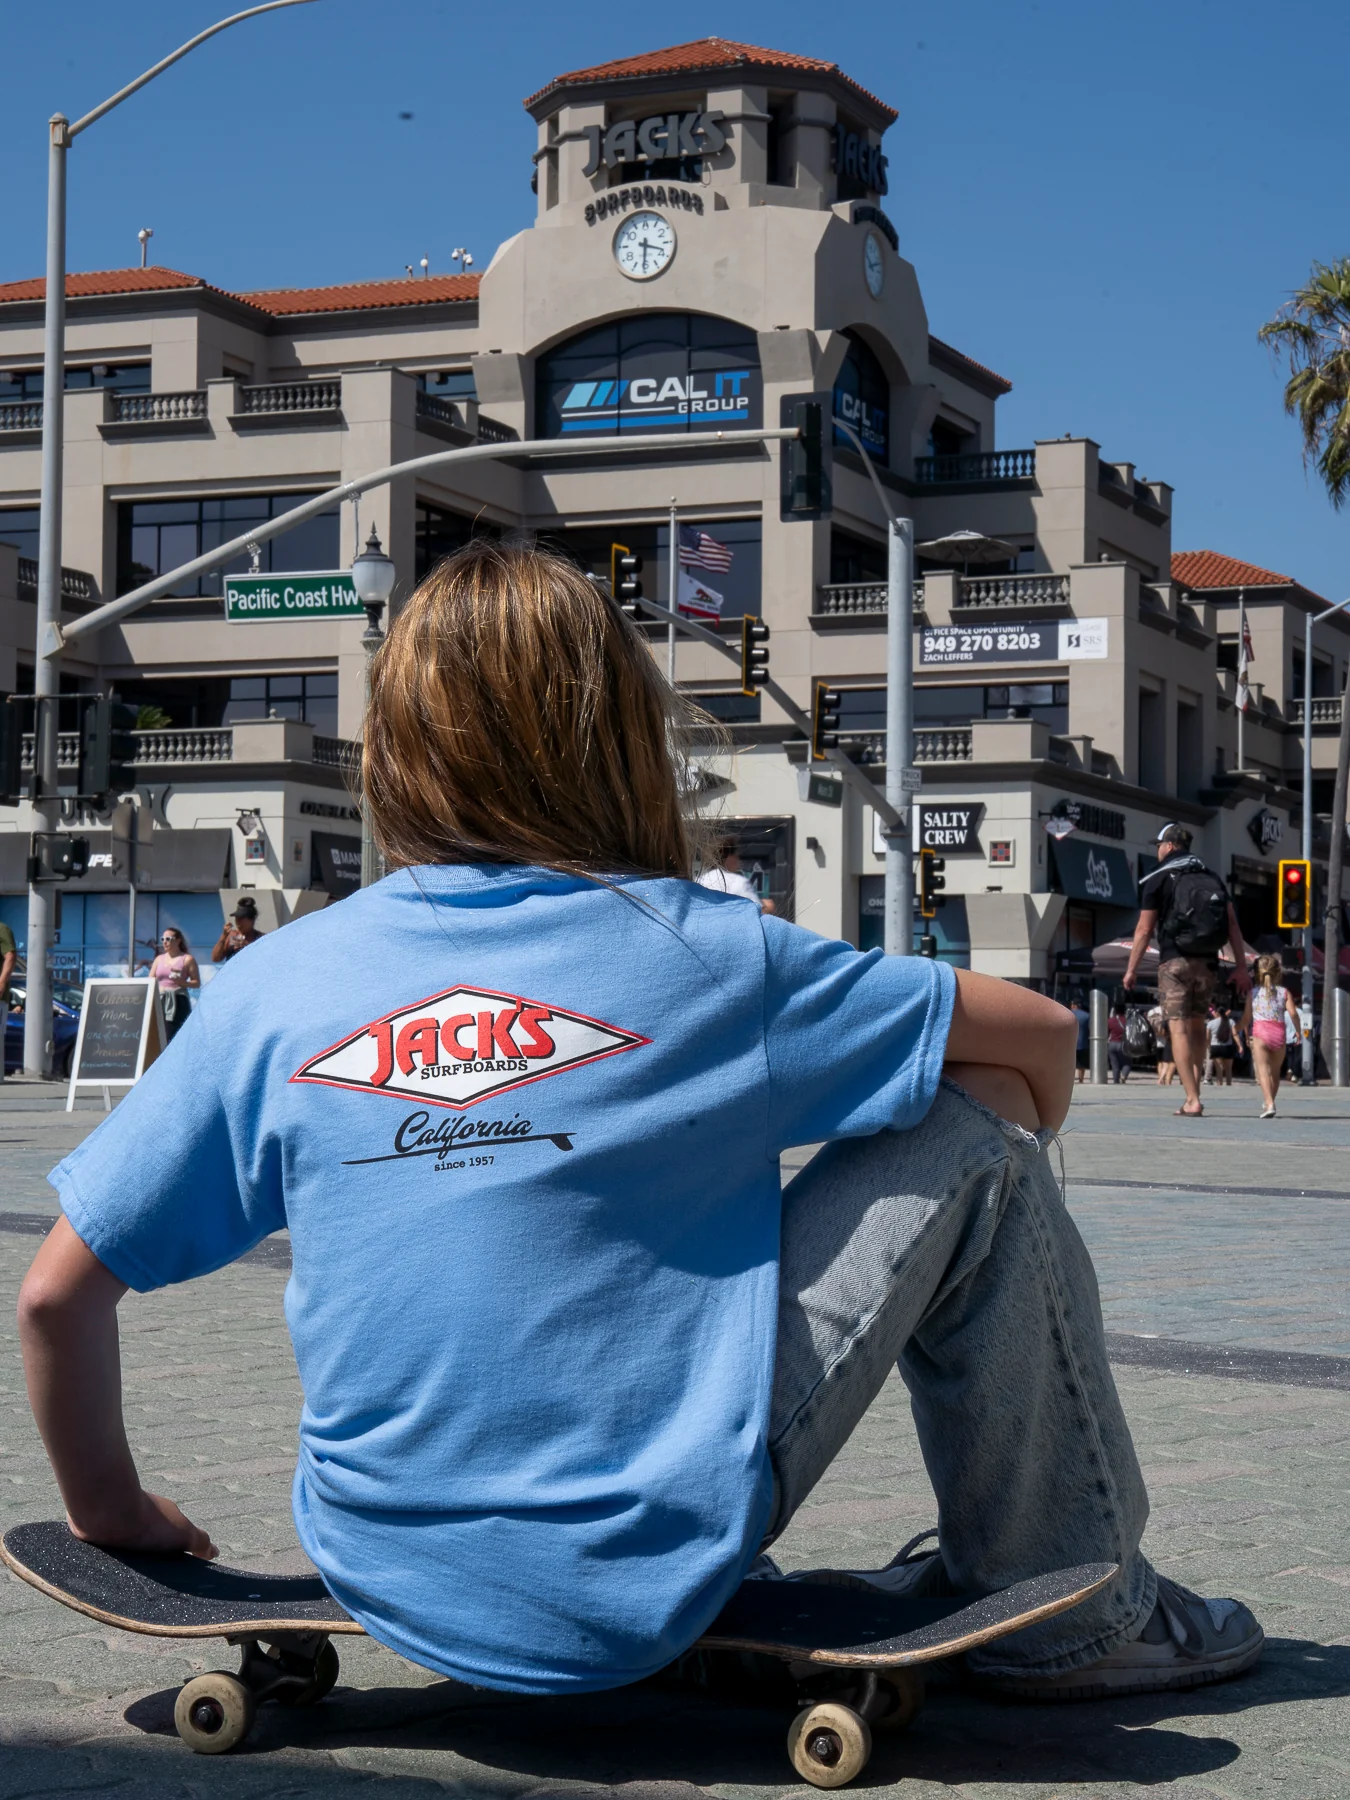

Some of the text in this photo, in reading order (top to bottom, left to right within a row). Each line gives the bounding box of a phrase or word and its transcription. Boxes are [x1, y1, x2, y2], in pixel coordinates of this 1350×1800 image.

[584, 185, 704, 222] SURFBOARDS
[630, 371, 750, 404] CAL IT
[678, 397, 749, 414] GROUP
[842, 392, 871, 427] CAL
[228, 585, 359, 611] Pacific Coast Hw
[924, 625, 1025, 636] OFFICE SPACE OPPORTUNITY
[1083, 635, 1102, 645] SRS
[924, 632, 1041, 653] 949 270 8203
[923, 652, 974, 662] ZACH LEFFERS
[902, 770, 921, 780] TRUCK
[924, 812, 970, 828] SALTY
[924, 829, 968, 845] CREW
[368, 1000, 556, 1088] JACK'S
[421, 1059, 528, 1080] SURFBOARDS
[395, 1111, 533, 1160] California
[434, 1156, 495, 1172] since 1957
